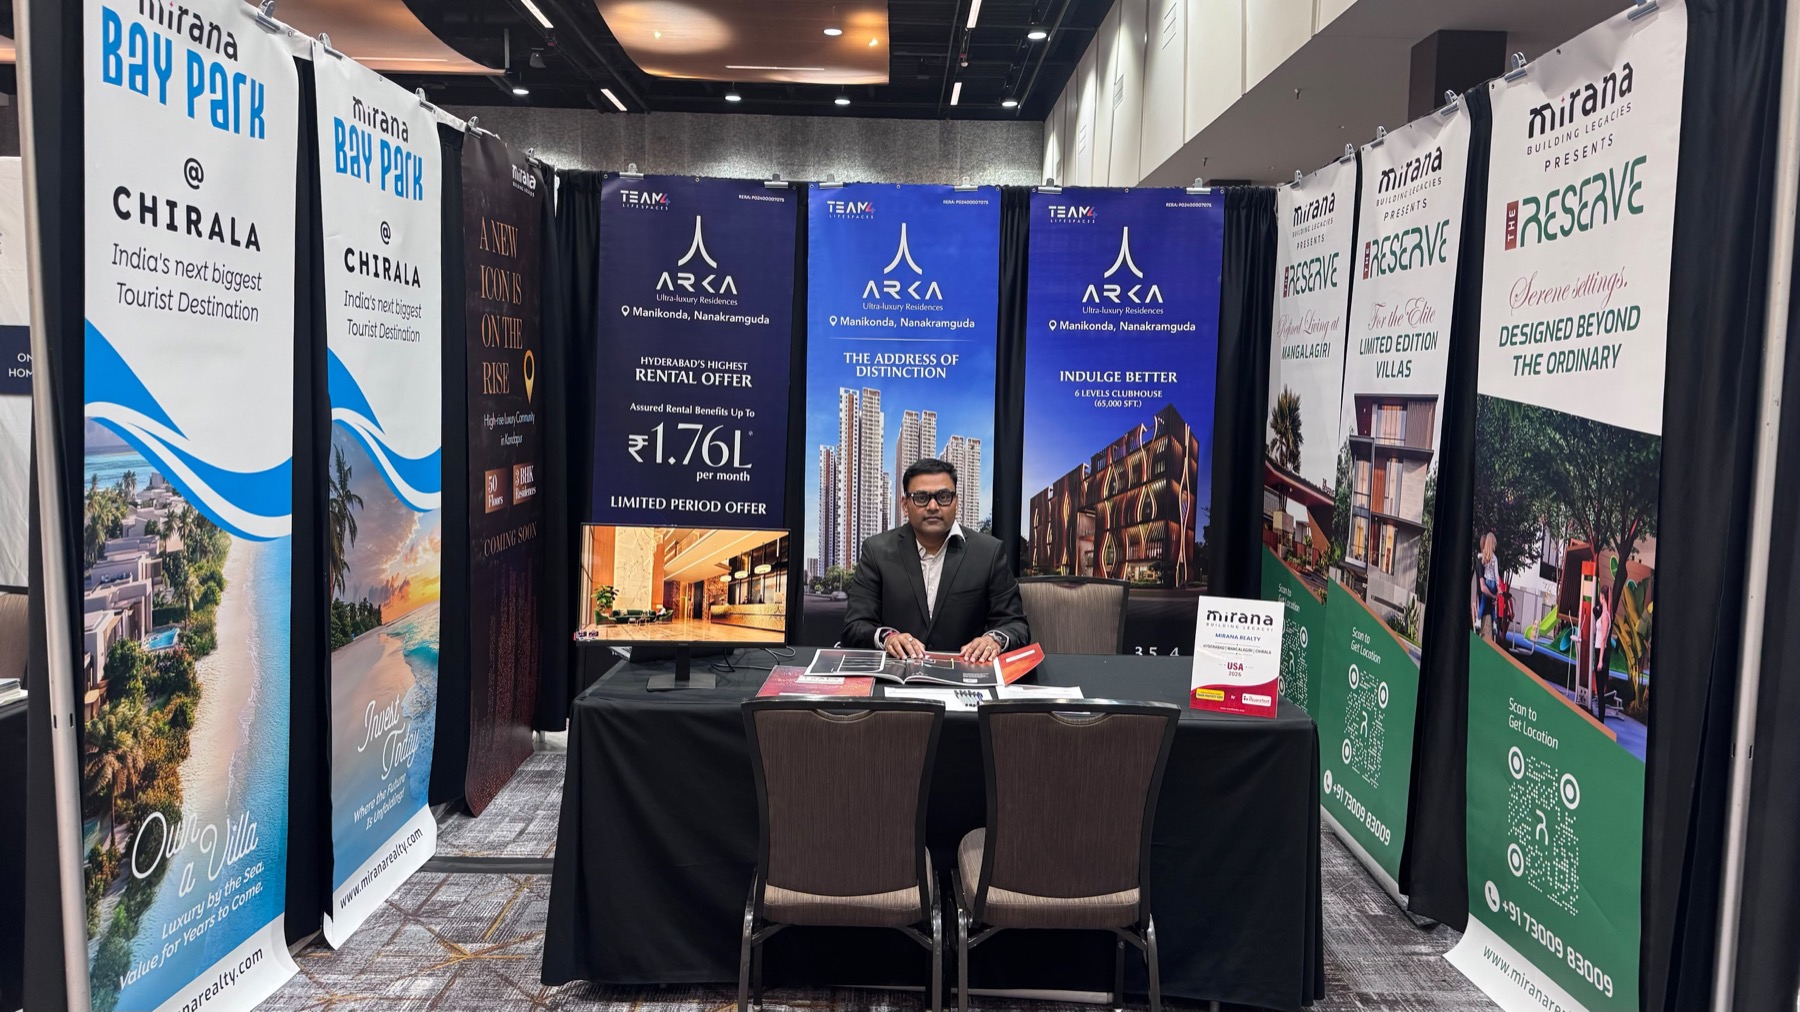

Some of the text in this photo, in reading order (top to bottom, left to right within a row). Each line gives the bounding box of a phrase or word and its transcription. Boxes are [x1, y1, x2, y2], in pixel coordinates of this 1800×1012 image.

[1528, 62, 1633, 139] mirana
[352, 95, 409, 143] mirana
[1527, 102, 1632, 155] BUILDING LEGACIES
[1544, 133, 1614, 172] PRESENTS
[184, 158, 204, 190] @
[511, 163, 537, 190] mirana
[1377, 145, 1443, 194] mirana
[1376, 177, 1442, 207] BUILDING LEGACIES
[1507, 154, 1647, 248] THE RESERVE
[113, 186, 261, 252] CHIRALA
[1293, 192, 1336, 228] mirana
[1311, 217, 1334, 231] LEGACIES
[1383, 198, 1428, 222] PRESENTS
[380, 221, 391, 245] @
[479, 216, 518, 259] A NEW
[1296, 233, 1325, 251] PRESENTS
[1369, 219, 1450, 279] RESERVE
[112, 243, 262, 292] India's next biggest
[344, 247, 421, 288] CHIRALA
[655, 271, 738, 295] ARKA
[1287, 251, 1340, 298] RESERVE
[480, 265, 522, 305] ICON IS
[656, 293, 738, 306] Ultra-luxury Residences
[862, 280, 943, 300] ARKA
[1509, 270, 1571, 317] Serene
[117, 282, 259, 323] Tourist Destination
[344, 290, 422, 320] India's next biggest
[632, 307, 770, 326] Manikonda, Nanakramguda
[1368, 296, 1437, 330] For the Elite
[346, 319, 420, 343] Tourist Destination
[481, 314, 523, 350] ON THE
[840, 316, 975, 330] Manikonda, Nanakramguda
[1303, 309, 1330, 343] Living
[1499, 305, 1641, 347] DESIGNED BEYOND
[843, 352, 959, 366] THE ADDRESS OF
[1281, 342, 1331, 360] MANGALAGIRI
[1359, 331, 1438, 355] LIMITED EDITION
[640, 356, 748, 371] HYDERABAD'S HIGHEST
[856, 366, 946, 379] DISTINCTION
[1376, 359, 1412, 379] VILLAS
[1513, 343, 1622, 377] THE ORDINARY
[482, 361, 510, 395] RISE
[635, 368, 752, 388] RENTAL OFFER
[1060, 370, 1178, 383] INDULGE BETTER
[1074, 389, 1163, 399] 6 LEVELS CLUBHOUSE
[1094, 399, 1142, 409] (65,000 SFT.)
[630, 402, 755, 419] Assured Rental Benefits Up To
[488, 474, 498, 493] 50
[515, 465, 534, 486] 3 BHK
[696, 471, 750, 482] per month
[488, 494, 504, 508] Floors
[610, 495, 767, 515] LIMITED PERIOD OFFER
[484, 521, 537, 557] COMING SOON
[1206, 609, 1274, 627] mirana
[1215, 632, 1238, 640] MIRANA
[1227, 661, 1244, 671] USA
[357, 694, 400, 752] Invest
[1508, 697, 1537, 722] Scan to
[1508, 715, 1559, 750] Get Location
[381, 722, 420, 781] Today
[353, 773, 407, 823] Where the Future
[365, 816, 373, 831] Is
[1332, 783, 1391, 846] +91 73009 83009
[200, 811, 259, 881] Villa
[339, 826, 424, 910] www.miranarealty.com
[161, 861, 265, 940] Luxury by the Sea.
[119, 881, 263, 990] Value for Years to Come.
[1502, 899, 1614, 998] +91 73009 83009
[178, 947, 264, 1012] narealty.com
